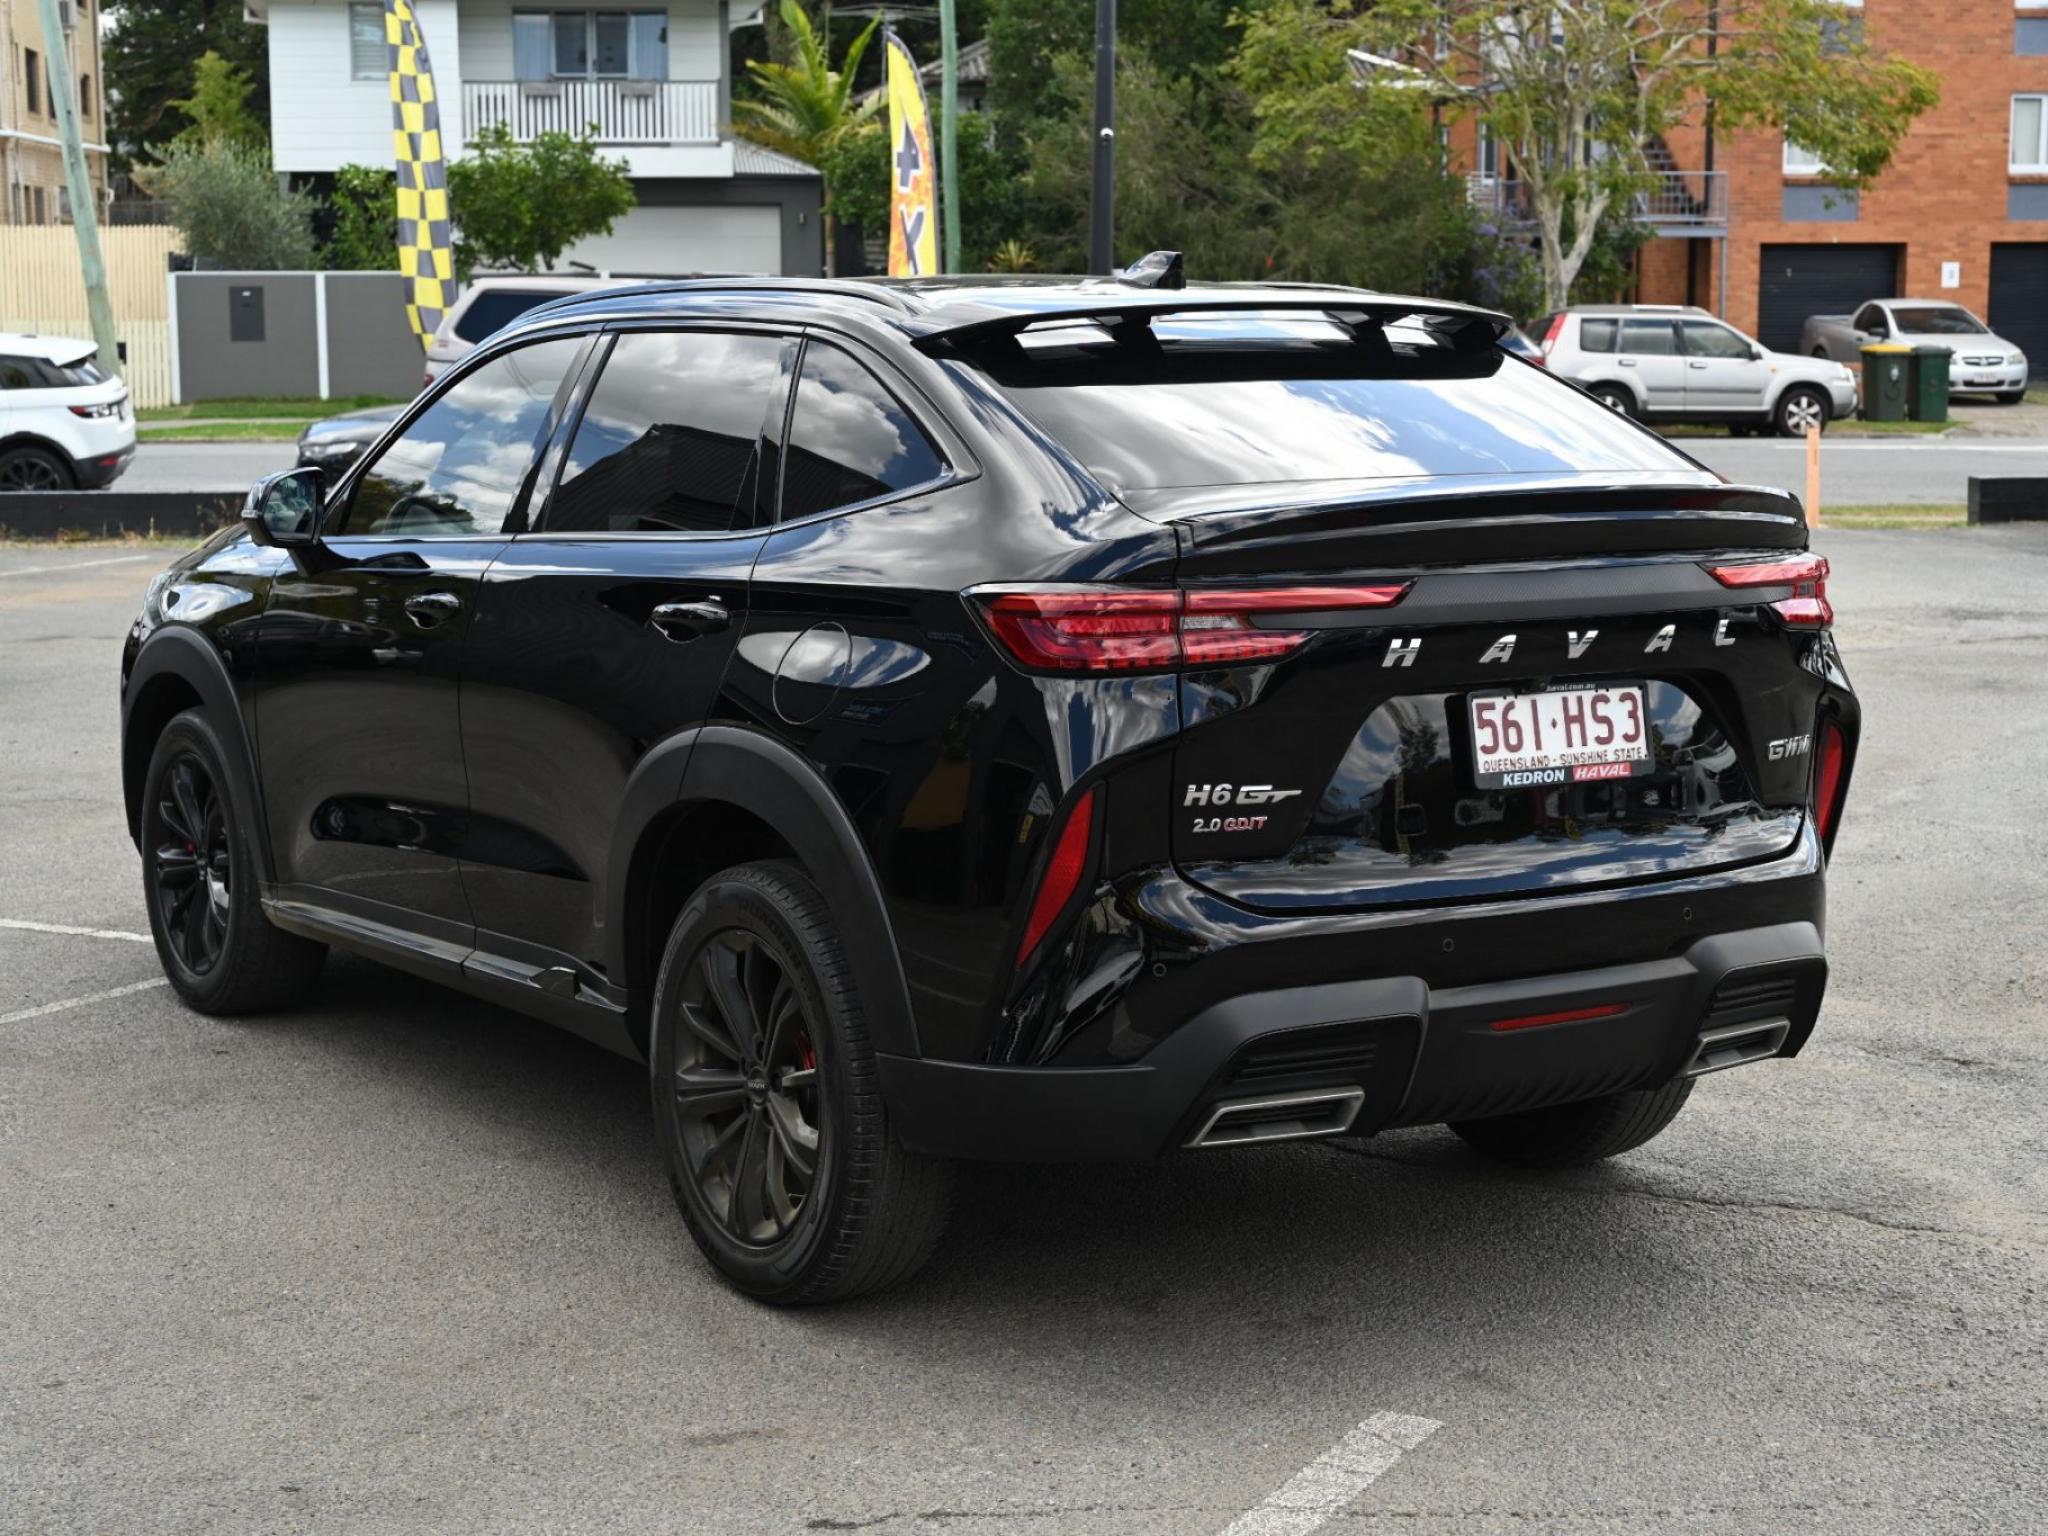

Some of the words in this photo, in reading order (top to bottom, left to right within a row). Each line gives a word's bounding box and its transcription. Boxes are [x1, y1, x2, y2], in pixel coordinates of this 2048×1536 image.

[1382, 619, 1736, 667] HAVAL
[1483, 755, 1551, 772] QUEENSLAND
[1560, 750, 1609, 765] SUNSHINE
[1614, 747, 1642, 760] STATE
[1503, 768, 1565, 786] KEDRON
[1575, 763, 1630, 779] HAVAL
[1183, 783, 1232, 806] H6
[1192, 817, 1222, 833] 2.0
